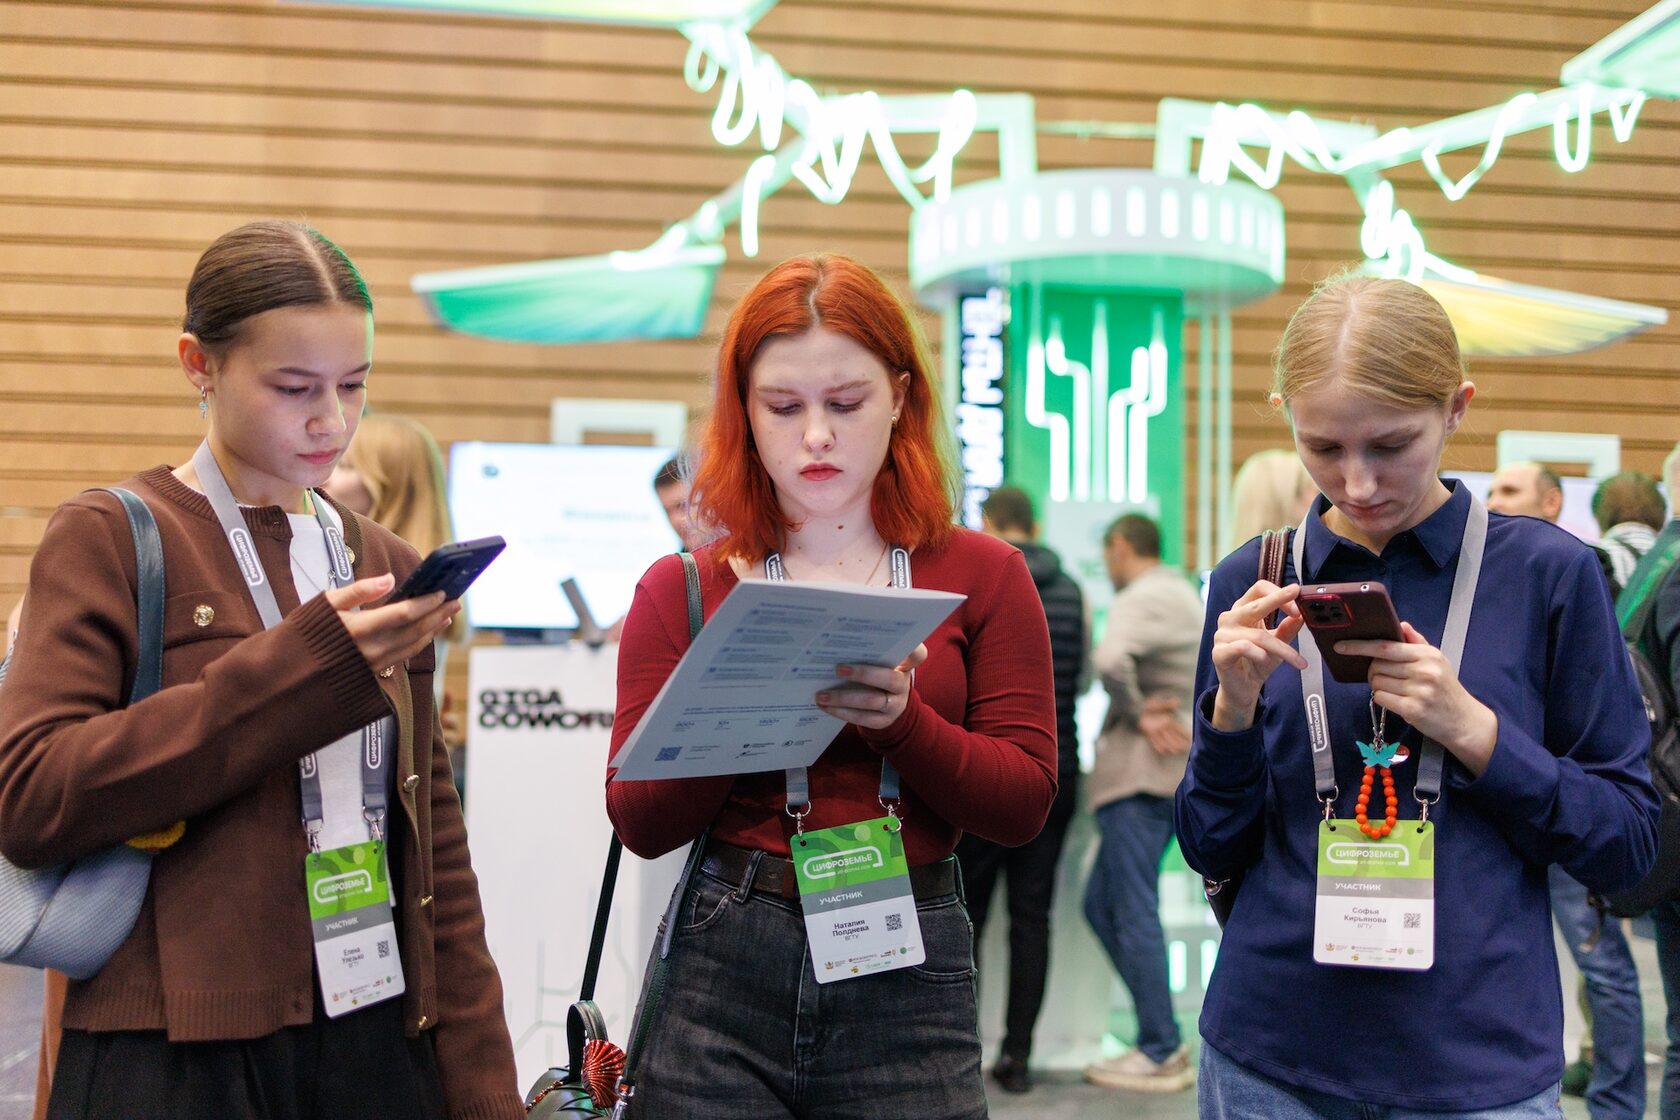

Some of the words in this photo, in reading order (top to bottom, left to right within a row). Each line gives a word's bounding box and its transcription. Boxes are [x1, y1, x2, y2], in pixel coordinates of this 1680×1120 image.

[479, 710, 614, 729] COWOR
[1335, 849, 1400, 859] ЦИФРОЗЕМЬЕ
[812, 853, 873, 872] ЦИФРОЗЕМЬЕ
[1335, 882, 1382, 891] УЧАСТНИК
[819, 890, 863, 905] УЧАСТНИК
[1352, 907, 1380, 916] Софья
[325, 916, 359, 931] УЧАСТНИК
[833, 919, 866, 930] Наталия
[1344, 914, 1387, 924] Кирьянова
[343, 946, 361, 957] Елена
